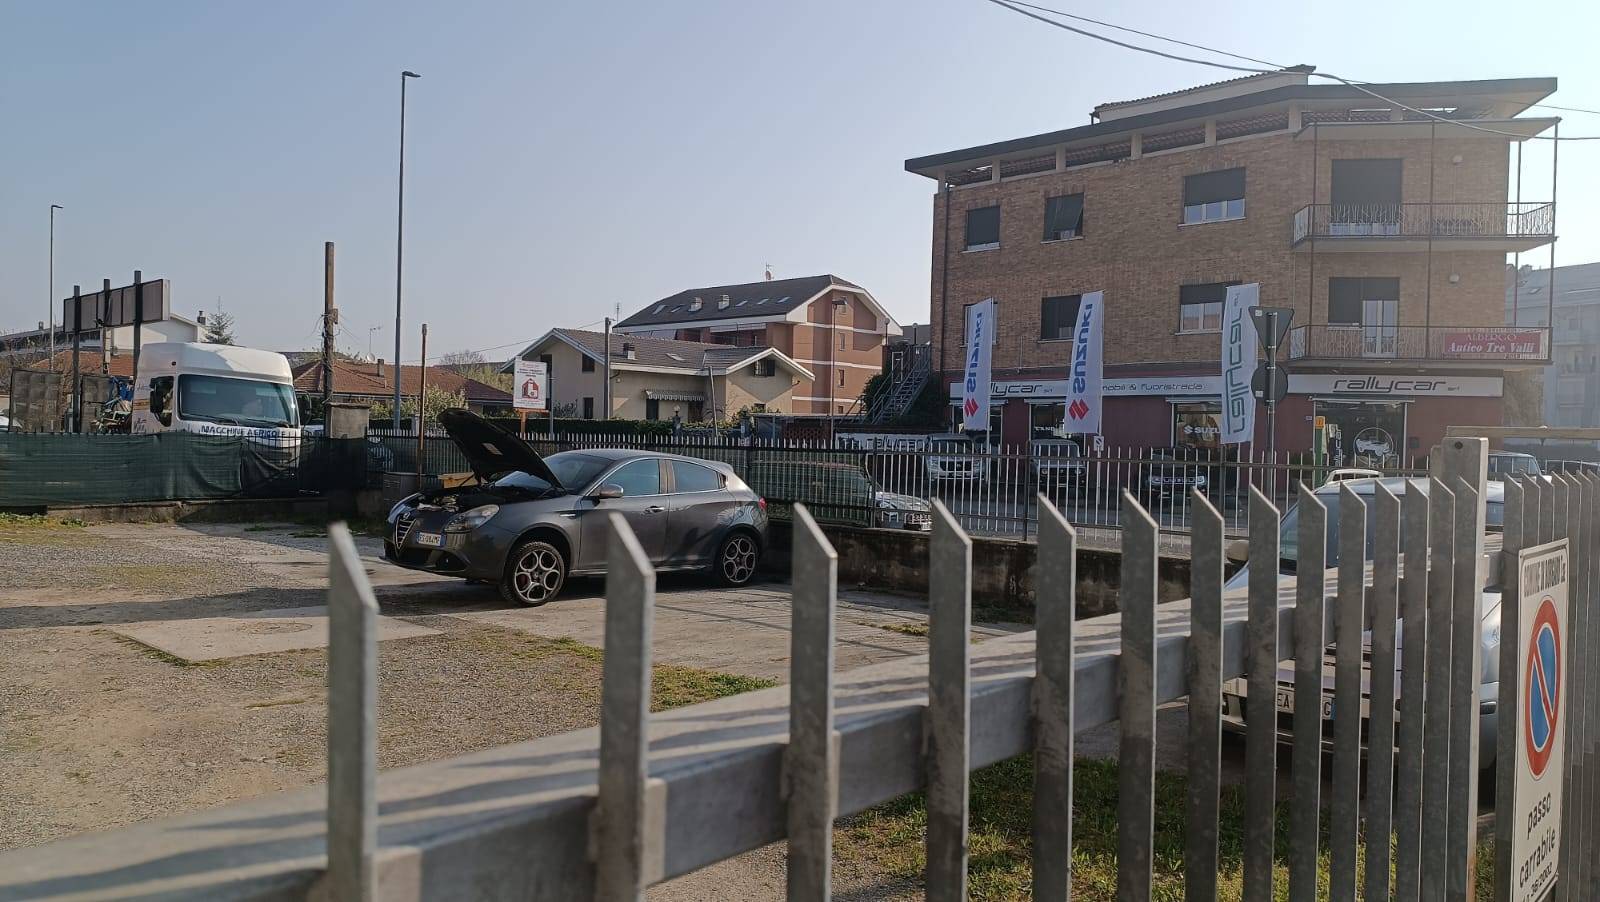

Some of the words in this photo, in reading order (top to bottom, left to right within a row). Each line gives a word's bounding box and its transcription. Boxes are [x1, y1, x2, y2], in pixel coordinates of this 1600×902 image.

[1448, 342, 1483, 353] Antico
[1486, 342, 1506, 353] Tre
[1510, 342, 1535, 353] Valli
[989, 382, 1043, 397] llycar
[1332, 376, 1446, 393] rallycar
[1526, 792, 1551, 840] passo
[1519, 826, 1556, 889] carrabile
